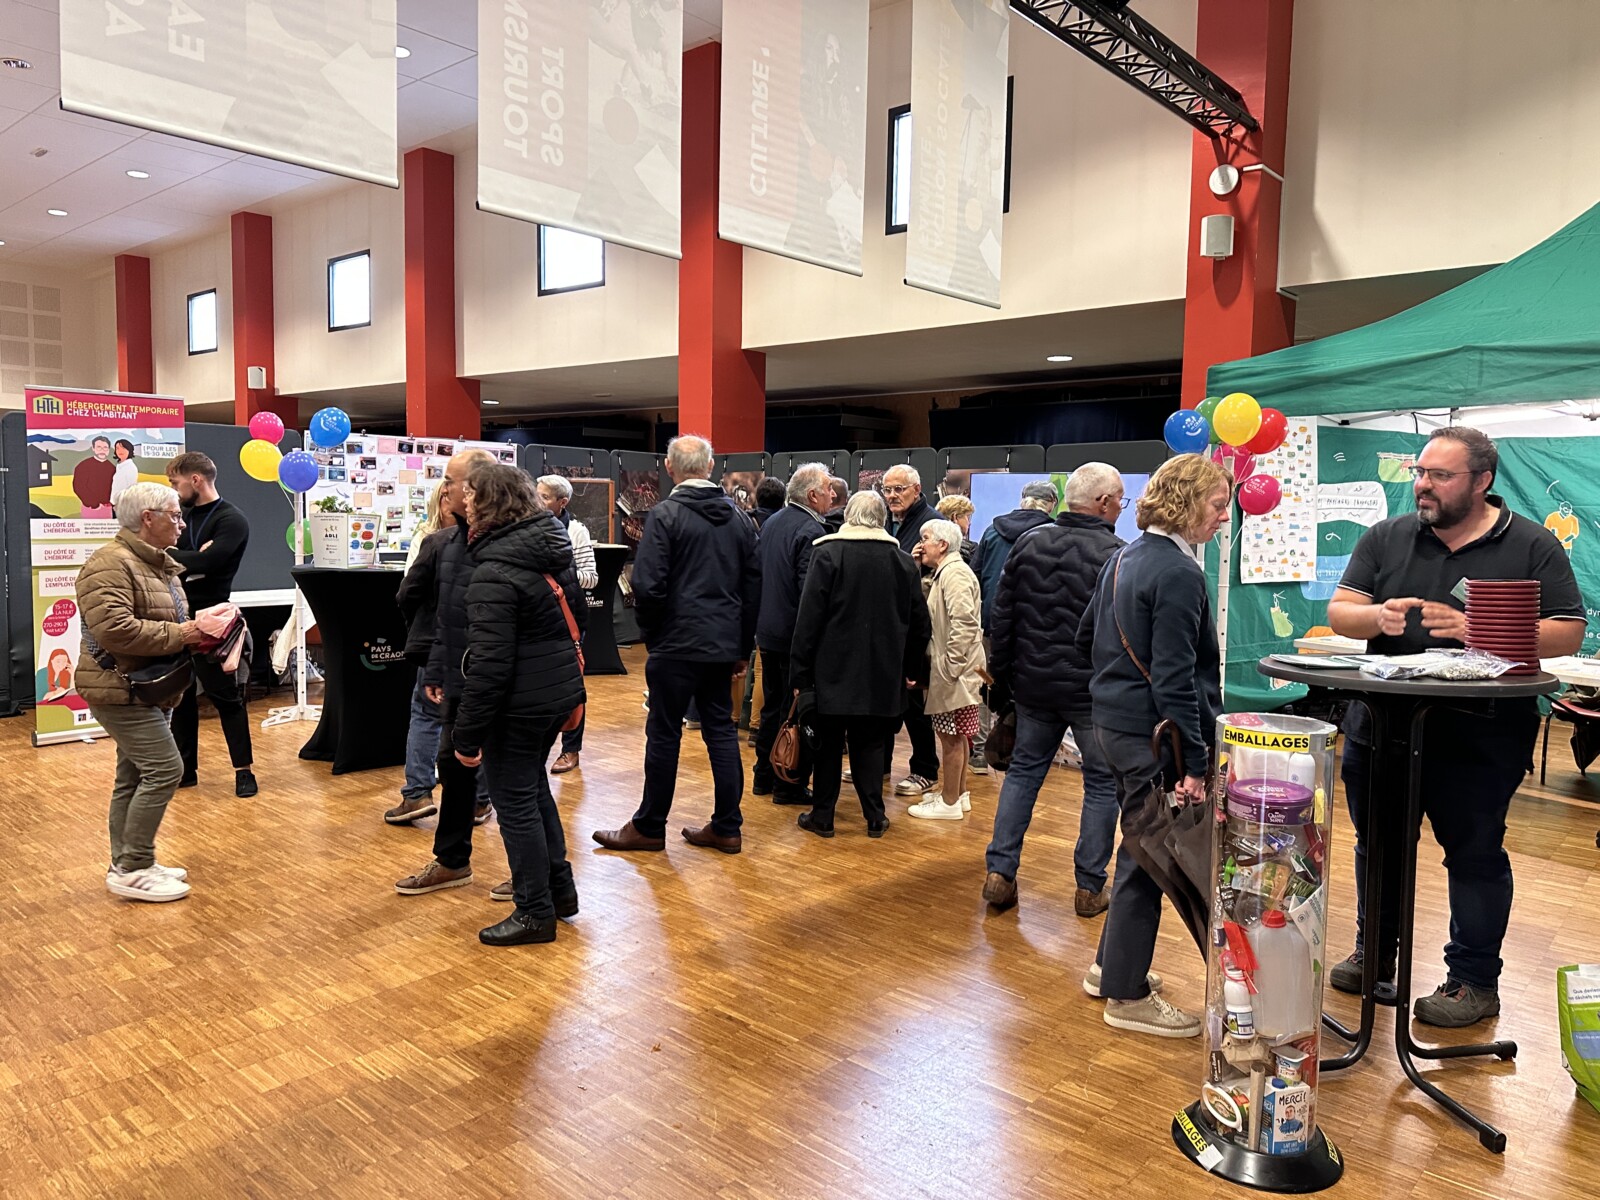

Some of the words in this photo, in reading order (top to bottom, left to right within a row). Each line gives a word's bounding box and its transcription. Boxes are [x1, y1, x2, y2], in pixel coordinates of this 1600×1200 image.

[36, 398, 60, 414] HTH
[66, 400, 126, 412] HÉBERGEMENT
[130, 406, 179, 416] TEMPORAIRE
[66, 408, 90, 417] CHEZ
[92, 410, 138, 419] L'HABITANT
[1224, 730, 1309, 748] EMBALLAGES
